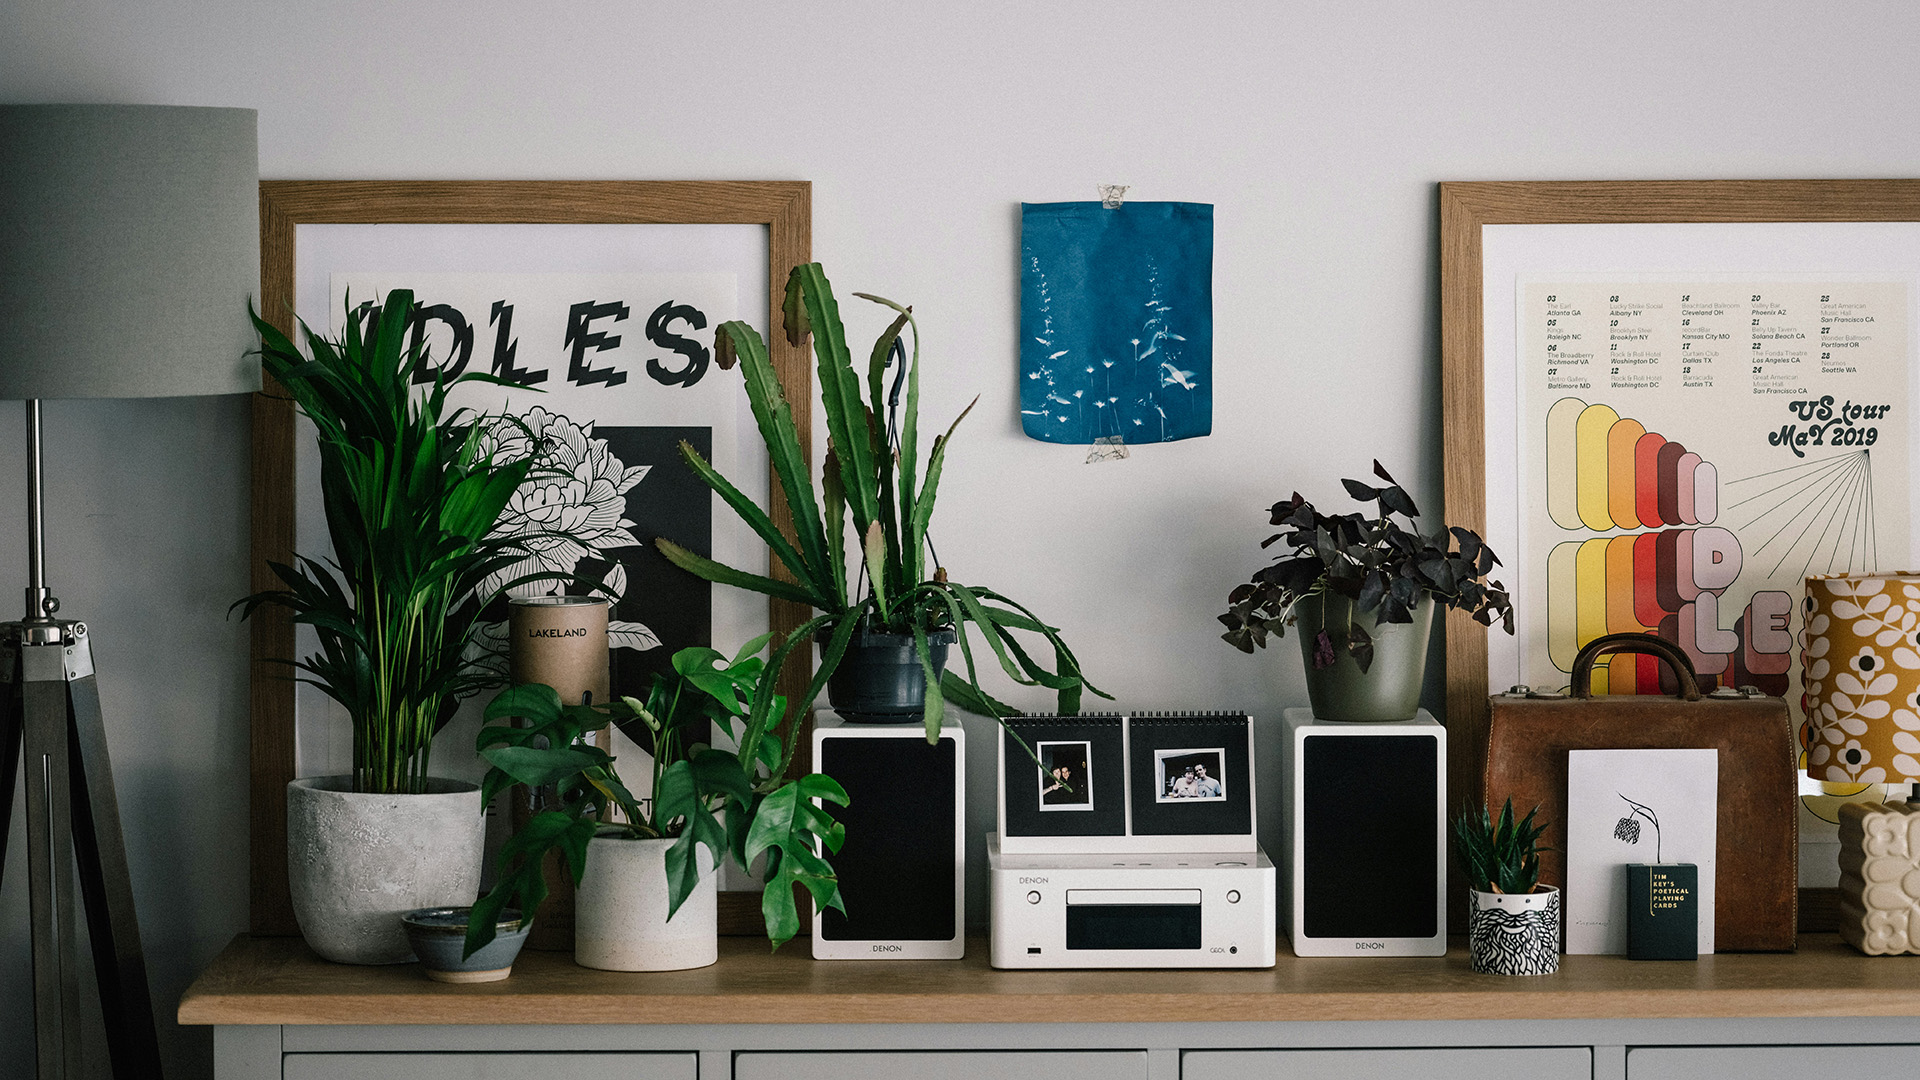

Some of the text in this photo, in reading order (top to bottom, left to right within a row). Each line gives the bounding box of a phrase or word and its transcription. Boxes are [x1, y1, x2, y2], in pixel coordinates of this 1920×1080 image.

[357, 300, 710, 387] IDLES
[1789, 395, 1891, 426] US tour
[1831, 427, 1878, 446] 2019
[529, 628, 587, 638] LAKELAND
[1355, 942, 1385, 950] DENON
